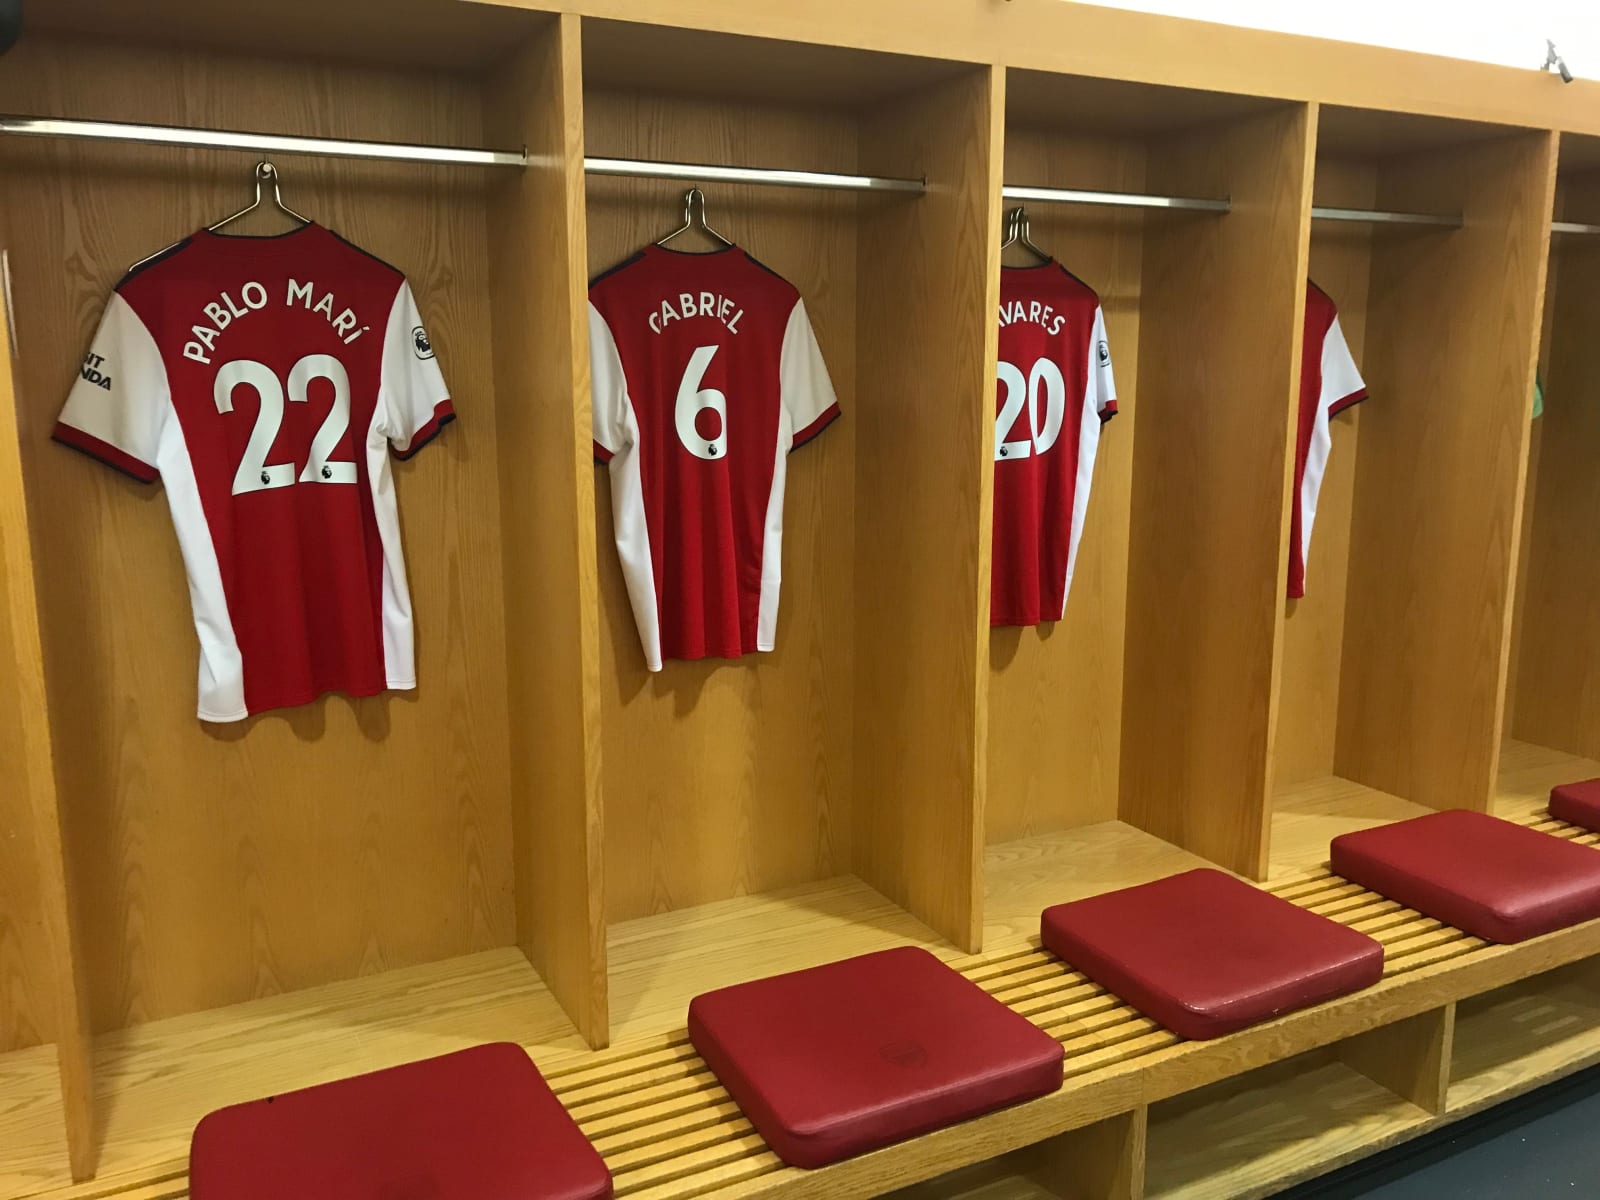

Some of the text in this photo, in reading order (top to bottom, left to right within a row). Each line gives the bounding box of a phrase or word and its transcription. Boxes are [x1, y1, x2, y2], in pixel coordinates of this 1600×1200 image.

[182, 278, 371, 365] PABLO MARÍ
[213, 353, 358, 497] 22
[674, 344, 728, 461] 6
[994, 357, 1066, 462] 20
